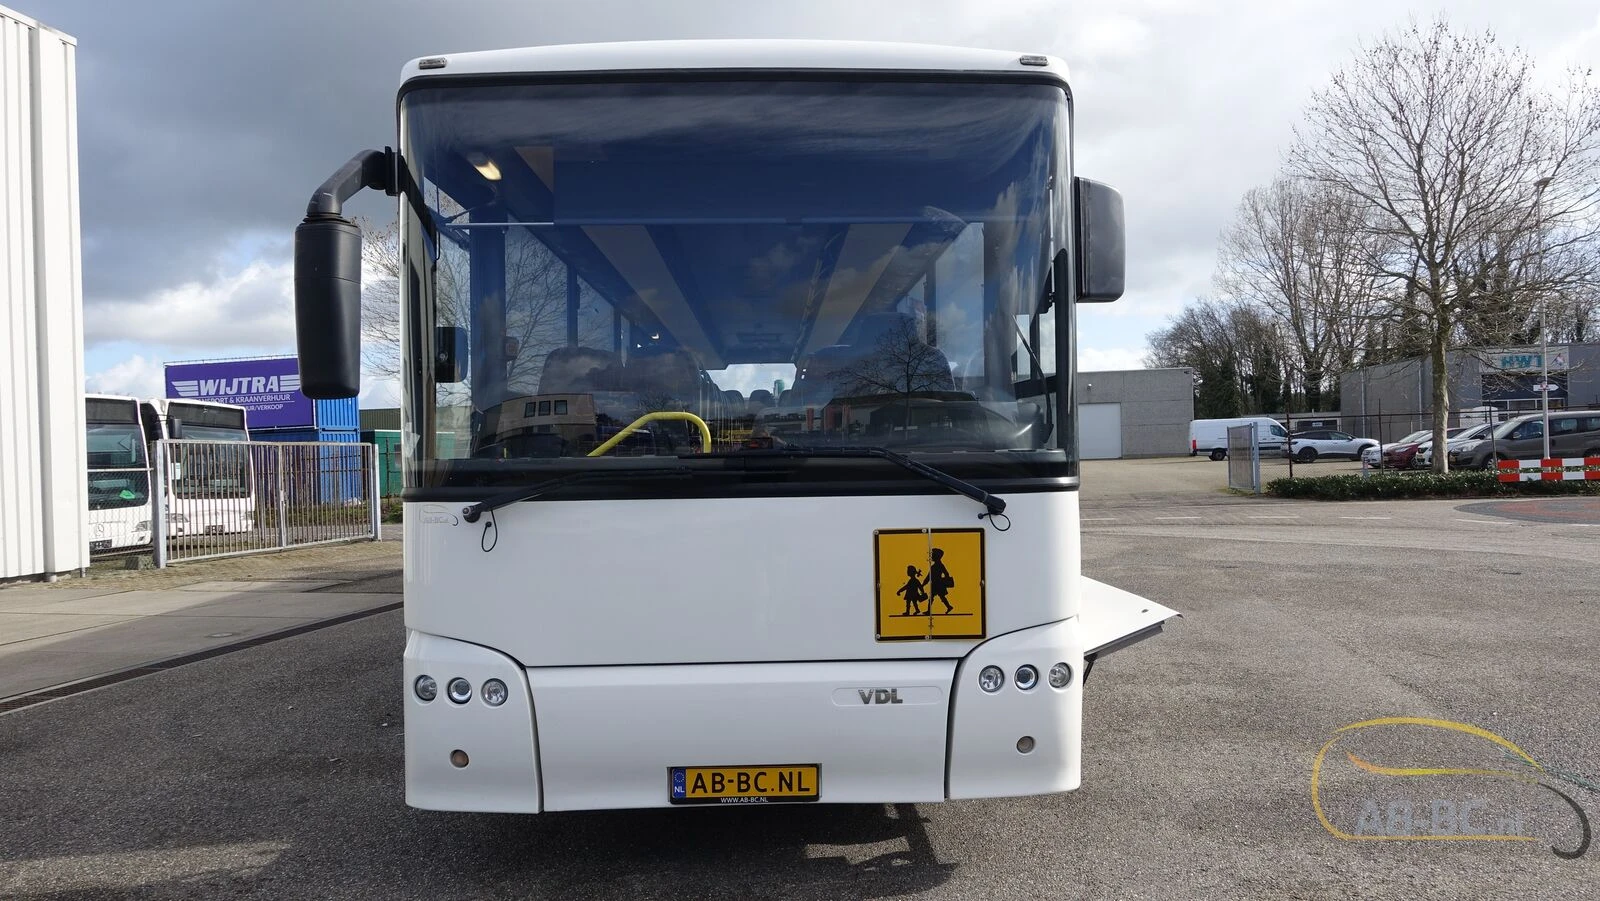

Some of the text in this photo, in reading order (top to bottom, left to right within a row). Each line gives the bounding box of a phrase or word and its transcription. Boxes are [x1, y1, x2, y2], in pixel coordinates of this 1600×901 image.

[200, 375, 279, 396] WIJTRA
[236, 394, 290, 404] KRAANVERHUUR
[858, 689, 903, 705] VDL
[691, 771, 811, 794] AB-BC.NL
